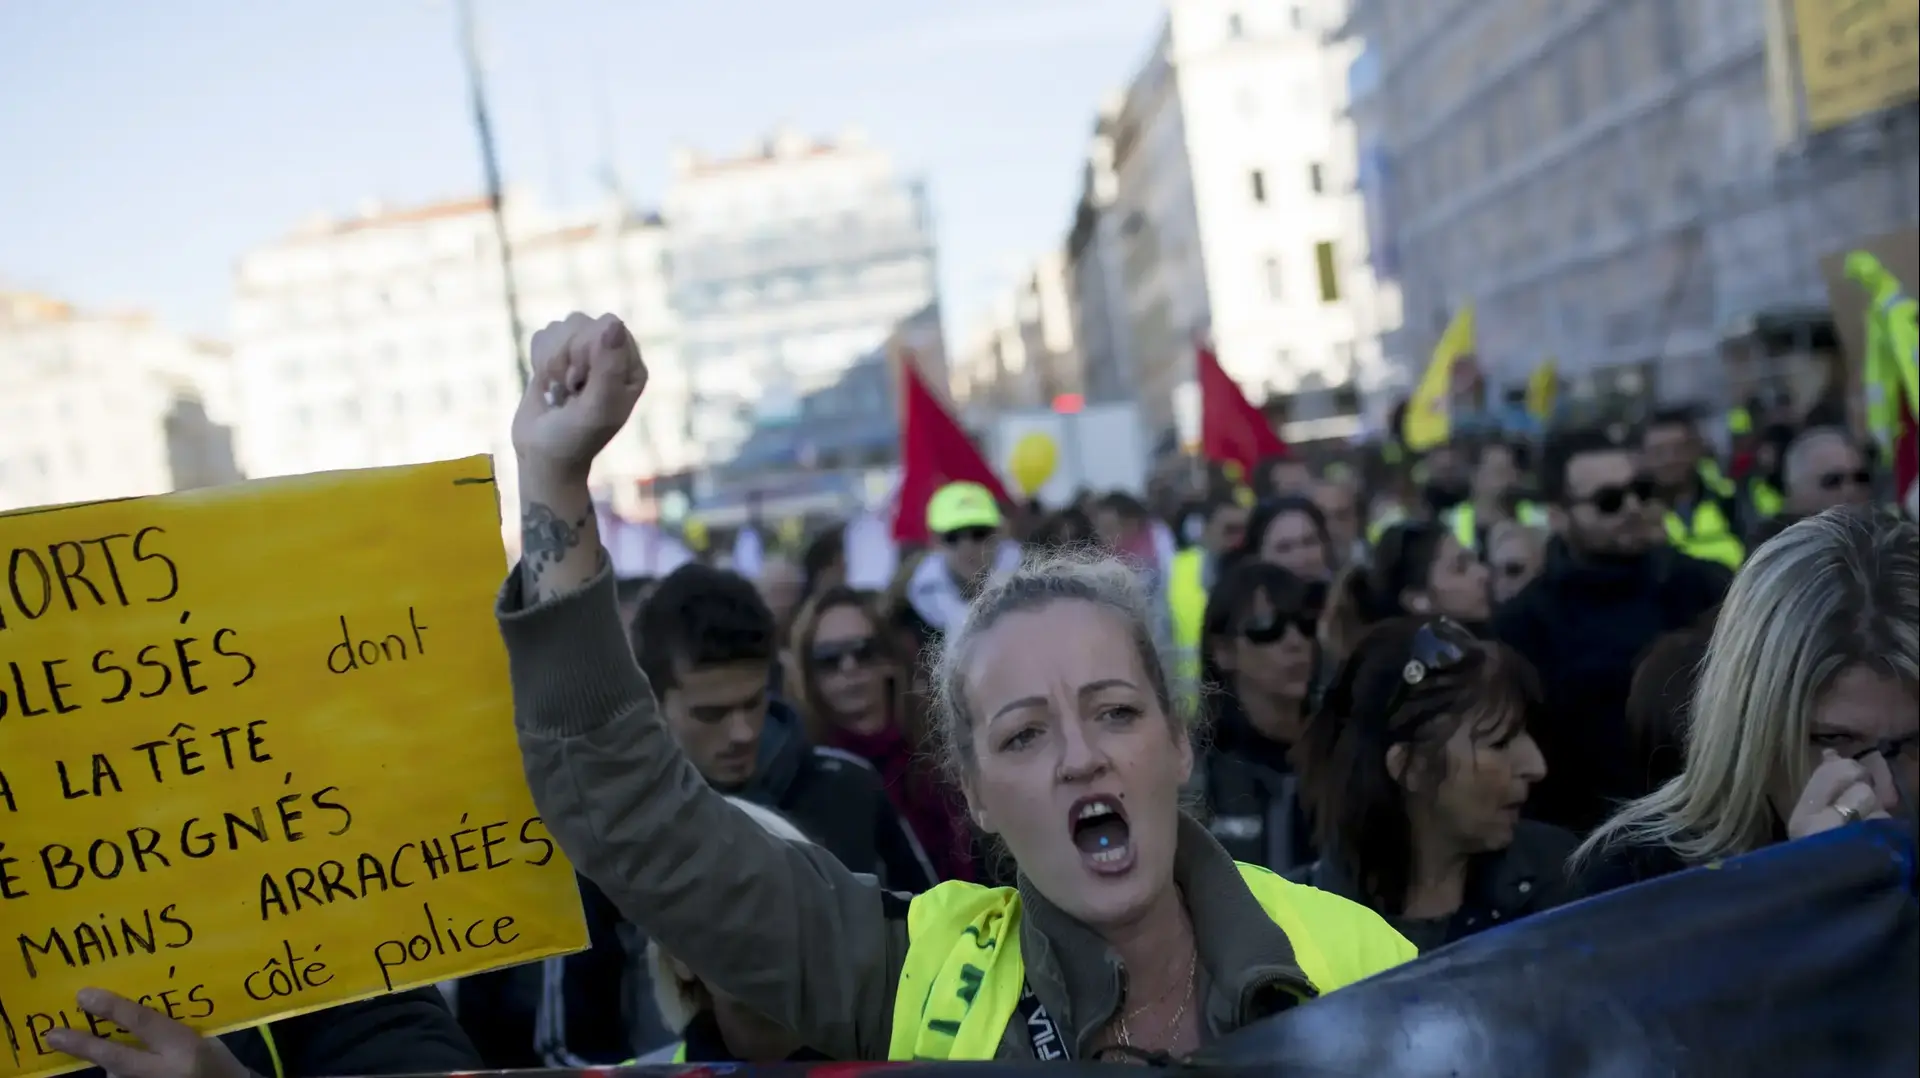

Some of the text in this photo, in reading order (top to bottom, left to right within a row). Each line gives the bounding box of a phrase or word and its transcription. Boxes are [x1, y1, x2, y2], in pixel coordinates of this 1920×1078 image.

[0, 526, 179, 631] ORTS
[0, 606, 428, 719] LESSÉS dont
[55, 753, 123, 799] LA
[131, 720, 273, 783] TÊTE
[260, 812, 554, 921] ARRACHÉES
[244, 940, 335, 1001] côté
[374, 902, 520, 991] police
[1028, 1004, 1061, 1061] FILA
